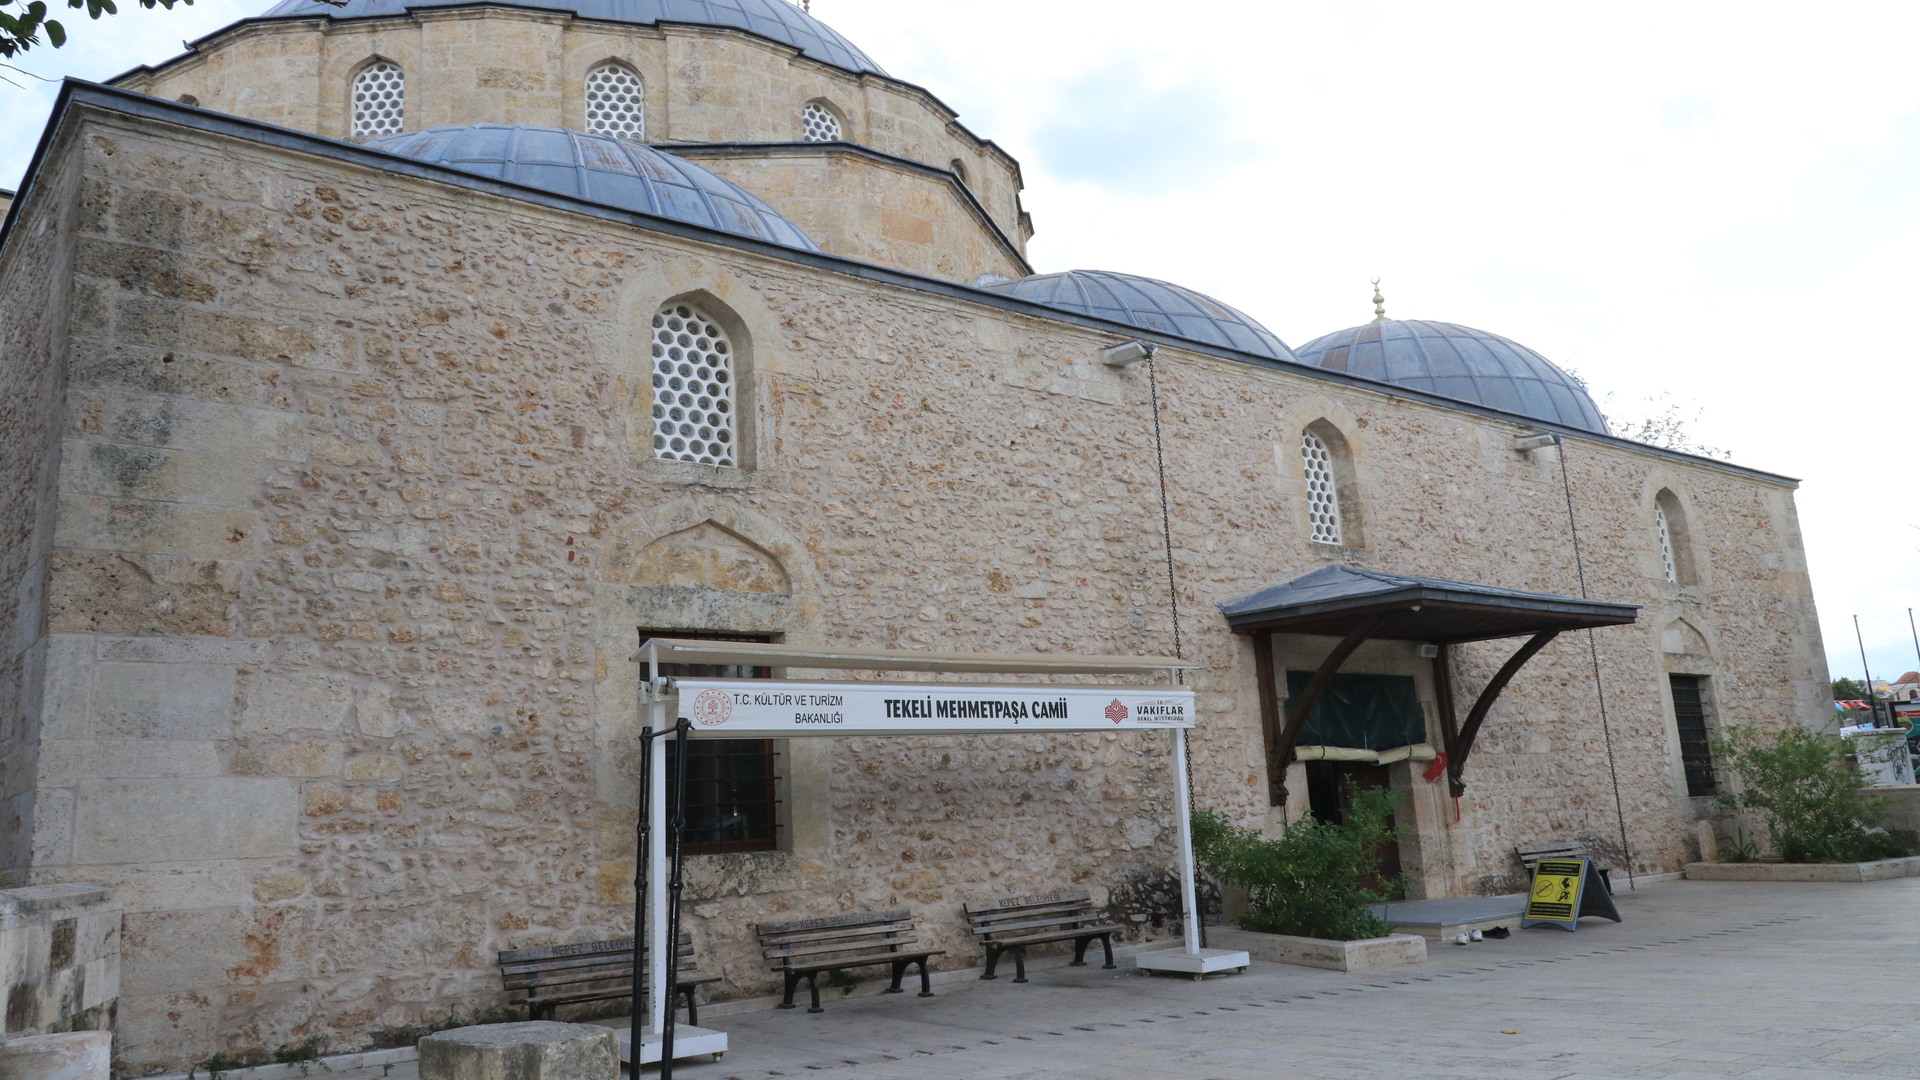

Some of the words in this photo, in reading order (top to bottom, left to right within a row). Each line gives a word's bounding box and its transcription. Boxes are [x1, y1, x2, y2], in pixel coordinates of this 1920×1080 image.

[734, 694, 752, 705] T.C.
[754, 693, 792, 706] KÜLTÜR
[794, 695, 806, 706] VE
[809, 693, 843, 706] TURİZM
[884, 695, 932, 718] TEKELİ
[936, 700, 1028, 724] MEHMETPAŞA
[1032, 697, 1068, 719] CAMİİ
[1136, 706, 1184, 715] VAKIFLAR
[795, 711, 843, 724] BAKANLIĞI
[998, 897, 1020, 908] KEPEZ
[552, 943, 584, 956] KEPEZ
